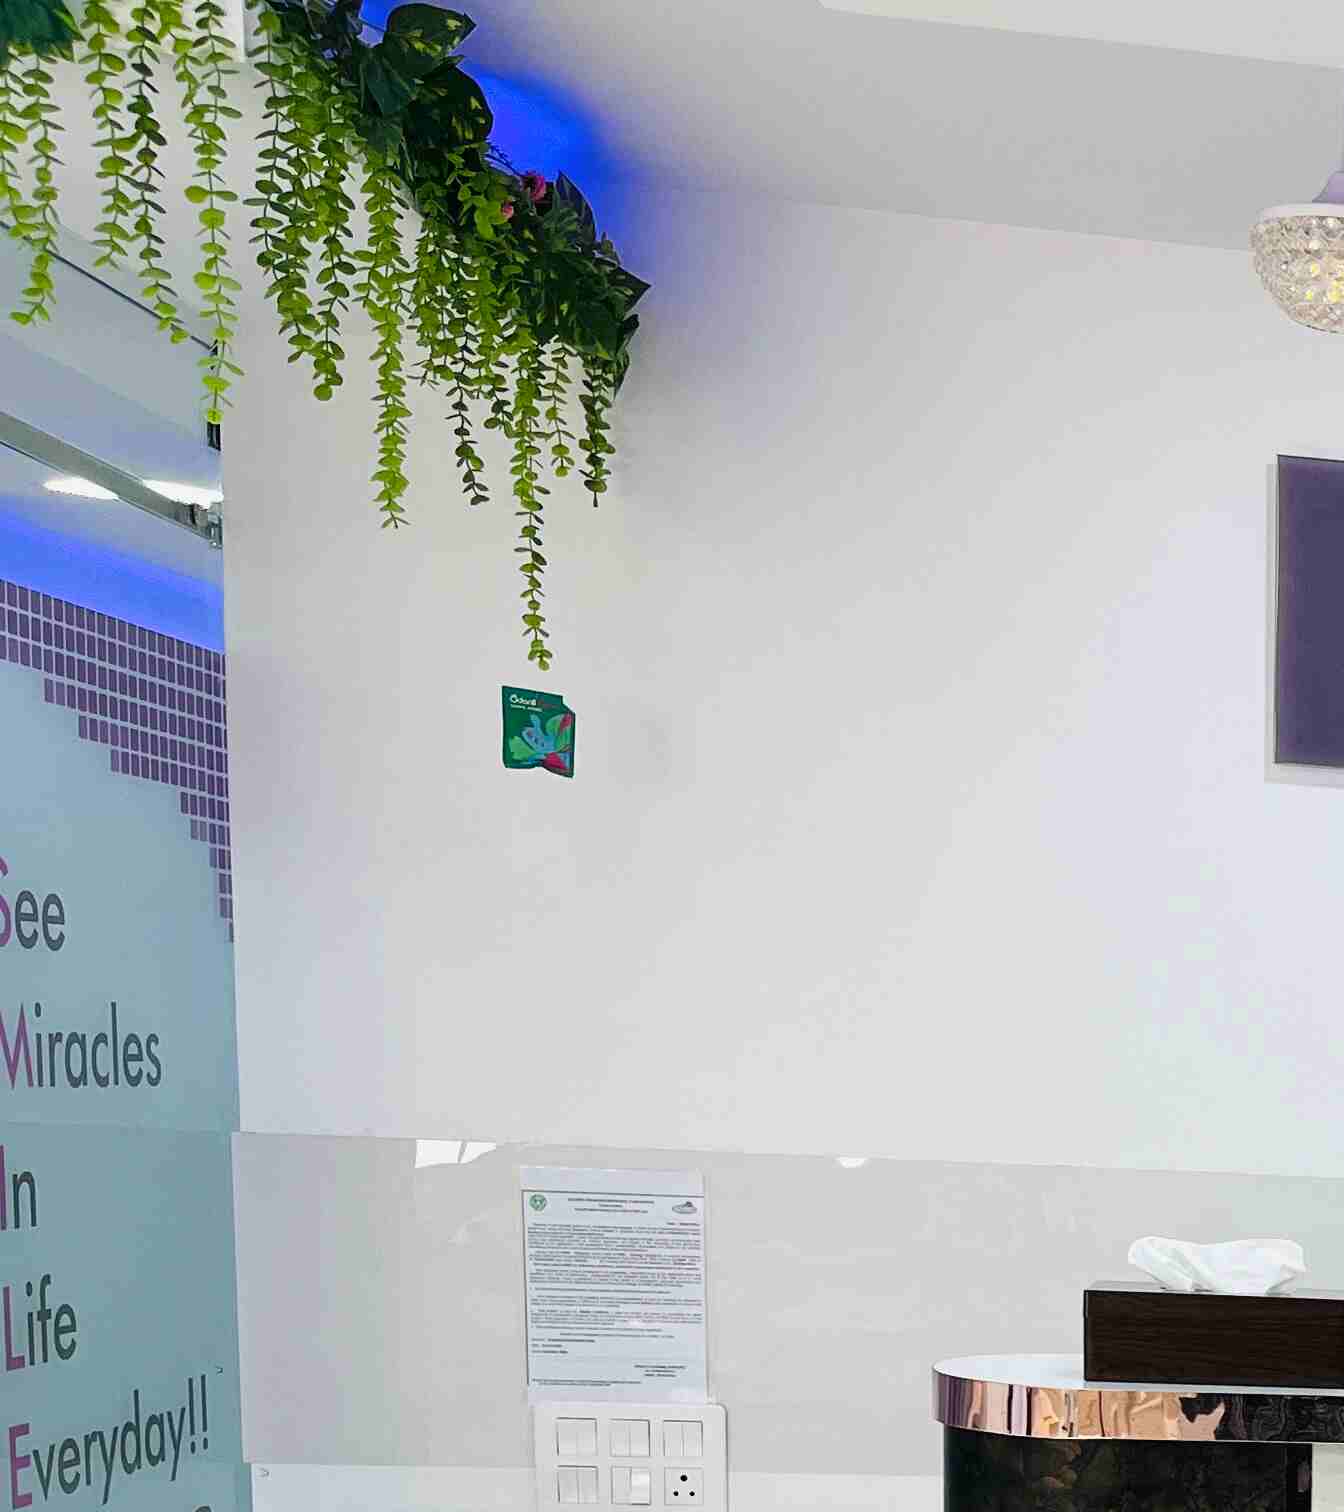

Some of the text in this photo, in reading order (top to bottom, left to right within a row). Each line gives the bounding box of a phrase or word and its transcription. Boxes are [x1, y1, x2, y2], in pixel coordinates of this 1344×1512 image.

[0, 1001, 162, 1090] Miracles
[3, 1274, 77, 1373] Life
[8, 1373, 209, 1511] Everyday!!
